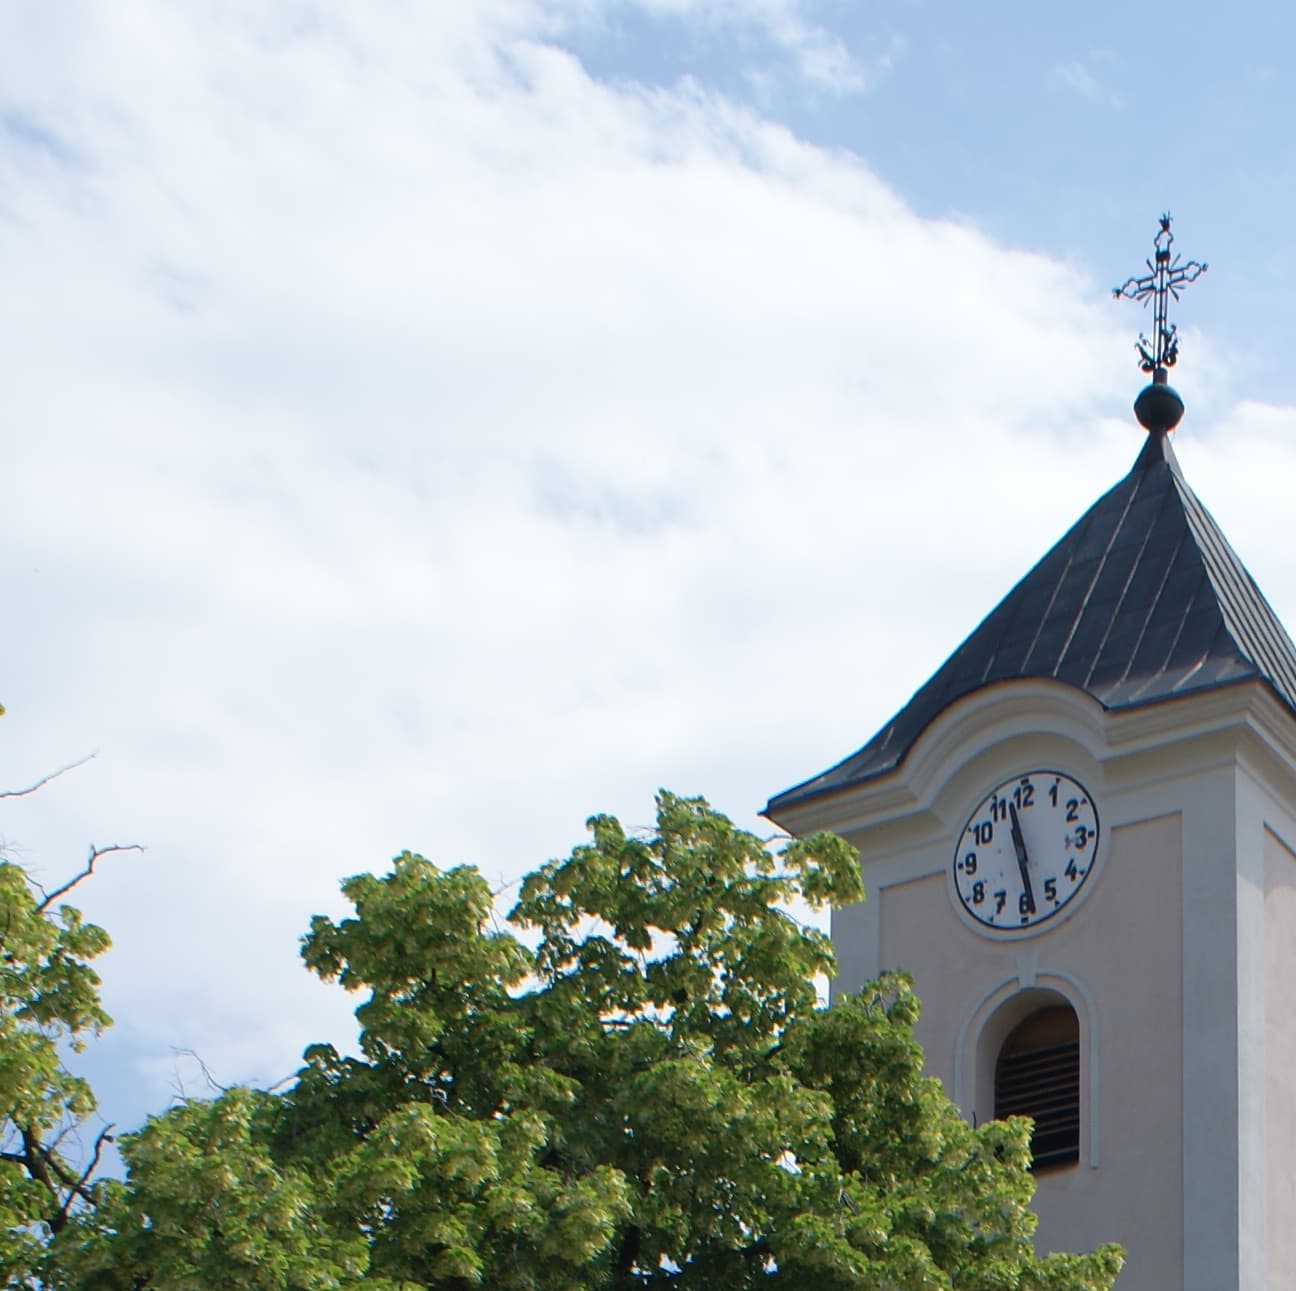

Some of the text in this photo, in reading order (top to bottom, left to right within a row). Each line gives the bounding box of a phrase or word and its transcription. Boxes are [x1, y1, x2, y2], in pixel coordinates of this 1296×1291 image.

[1014, 785, 1034, 810] 12
[1049, 785, 1058, 807] 1
[990, 798, 1006, 822] 11
[1066, 799, 1078, 822] 2
[973, 821, 993, 845] 10
[1075, 826, 1087, 849] 3
[965, 853, 977, 875] 9
[1065, 858, 1077, 881] 4
[973, 881, 984, 904] 8
[1044, 878, 1057, 901] 5
[994, 890, 1006, 914] 7
[1019, 893, 1031, 915] 6
